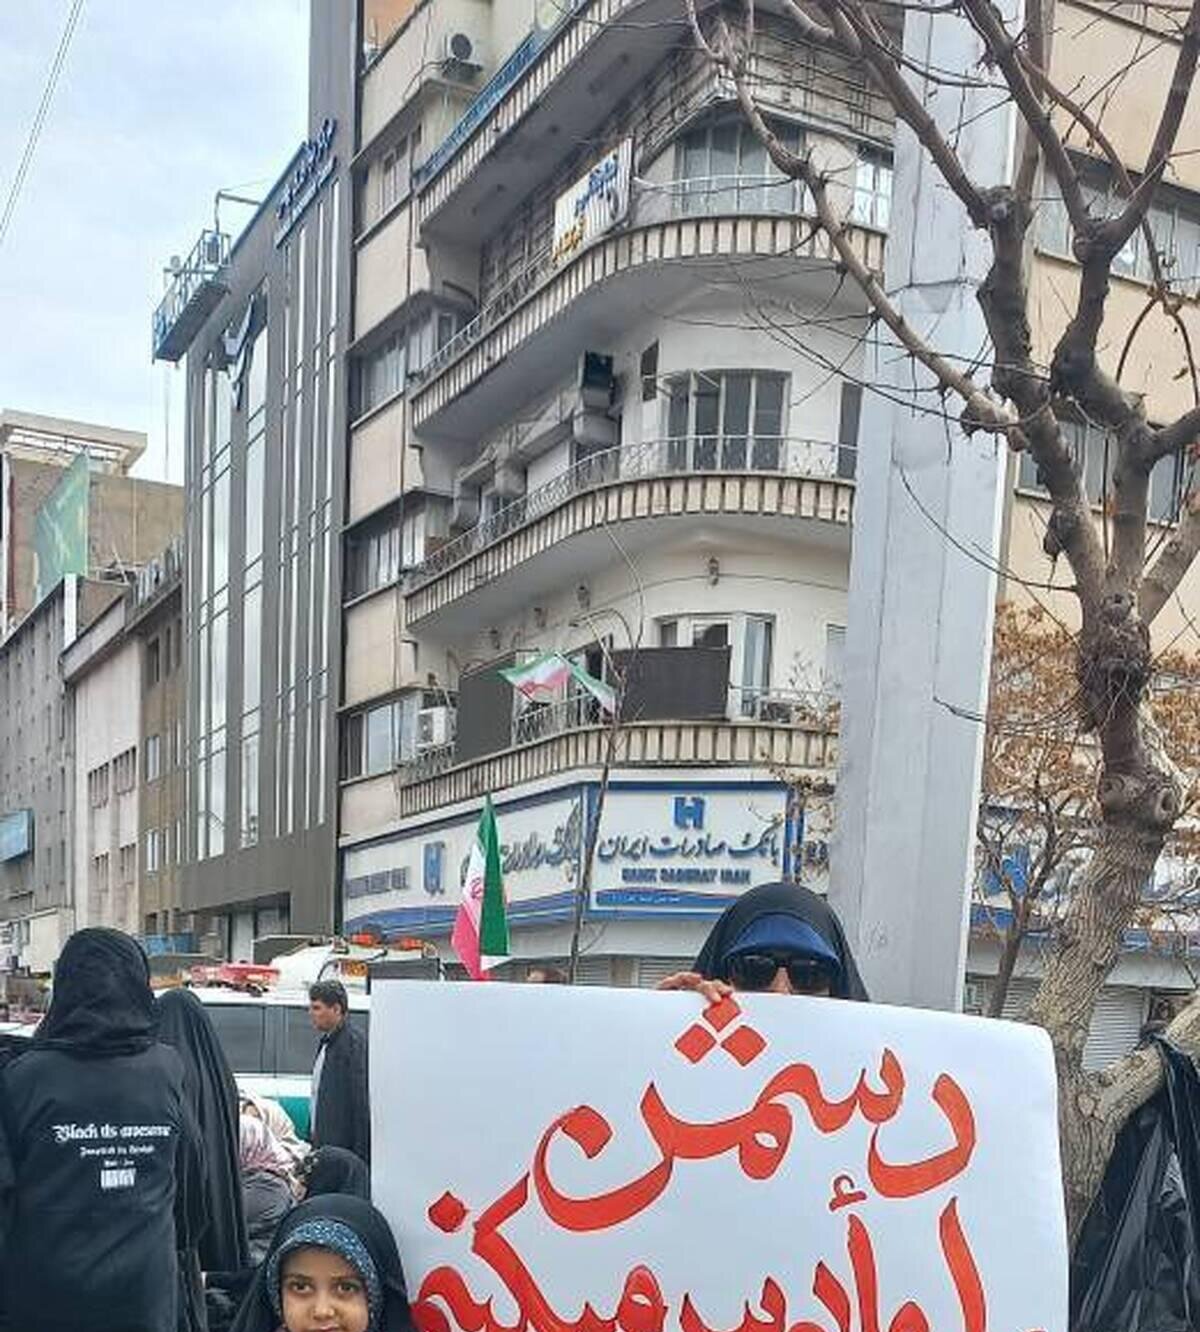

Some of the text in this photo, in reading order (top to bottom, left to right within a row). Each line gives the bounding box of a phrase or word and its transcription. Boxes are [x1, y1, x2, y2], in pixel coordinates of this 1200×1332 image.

[598, 834, 650, 863] ایران
[650, 832, 727, 858] صادرات
[729, 816, 784, 867] بانک
[532, 997, 977, 1232] دشمن
